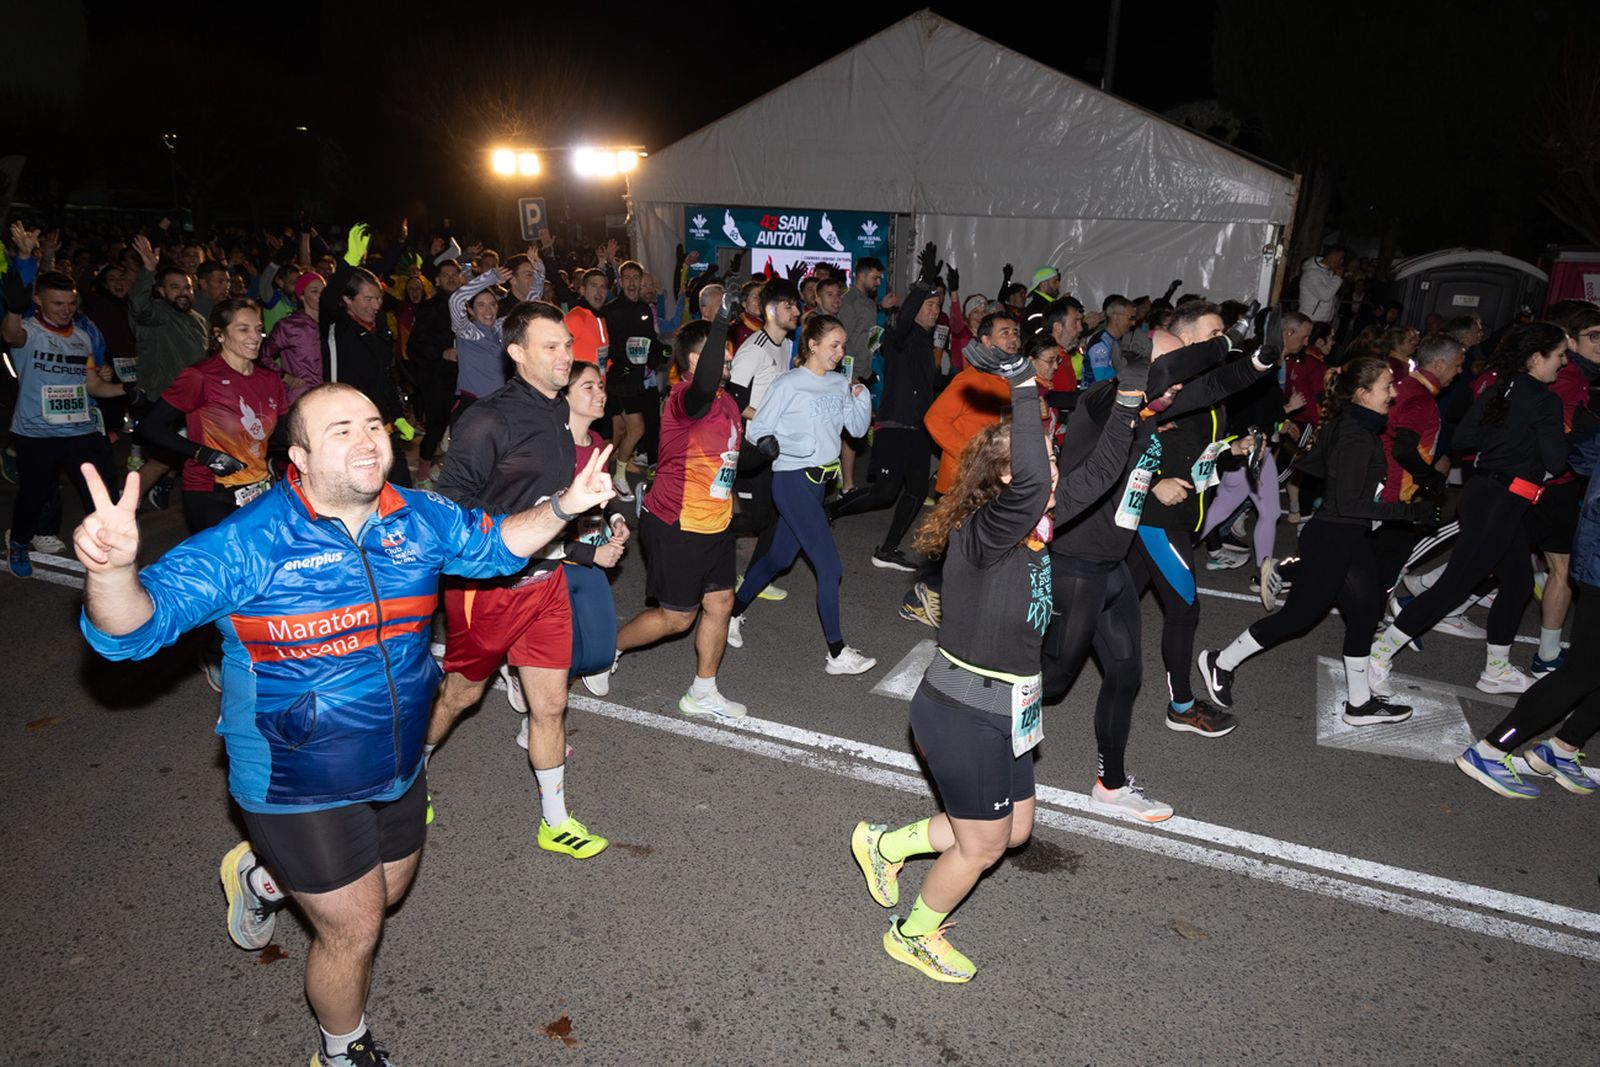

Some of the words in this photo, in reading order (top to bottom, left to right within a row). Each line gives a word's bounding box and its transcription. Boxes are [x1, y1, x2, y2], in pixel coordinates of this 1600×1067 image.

[525, 203, 541, 235] P
[760, 213, 778, 231] 43
[778, 215, 809, 230] SAN
[729, 229, 739, 241] 43
[755, 229, 806, 247] ANTÓN
[826, 234, 837, 246] 43
[33, 362, 87, 376] ALCAUDE
[48, 398, 84, 411] 13856
[284, 551, 343, 571] enerplus
[267, 607, 370, 641] Maratón
